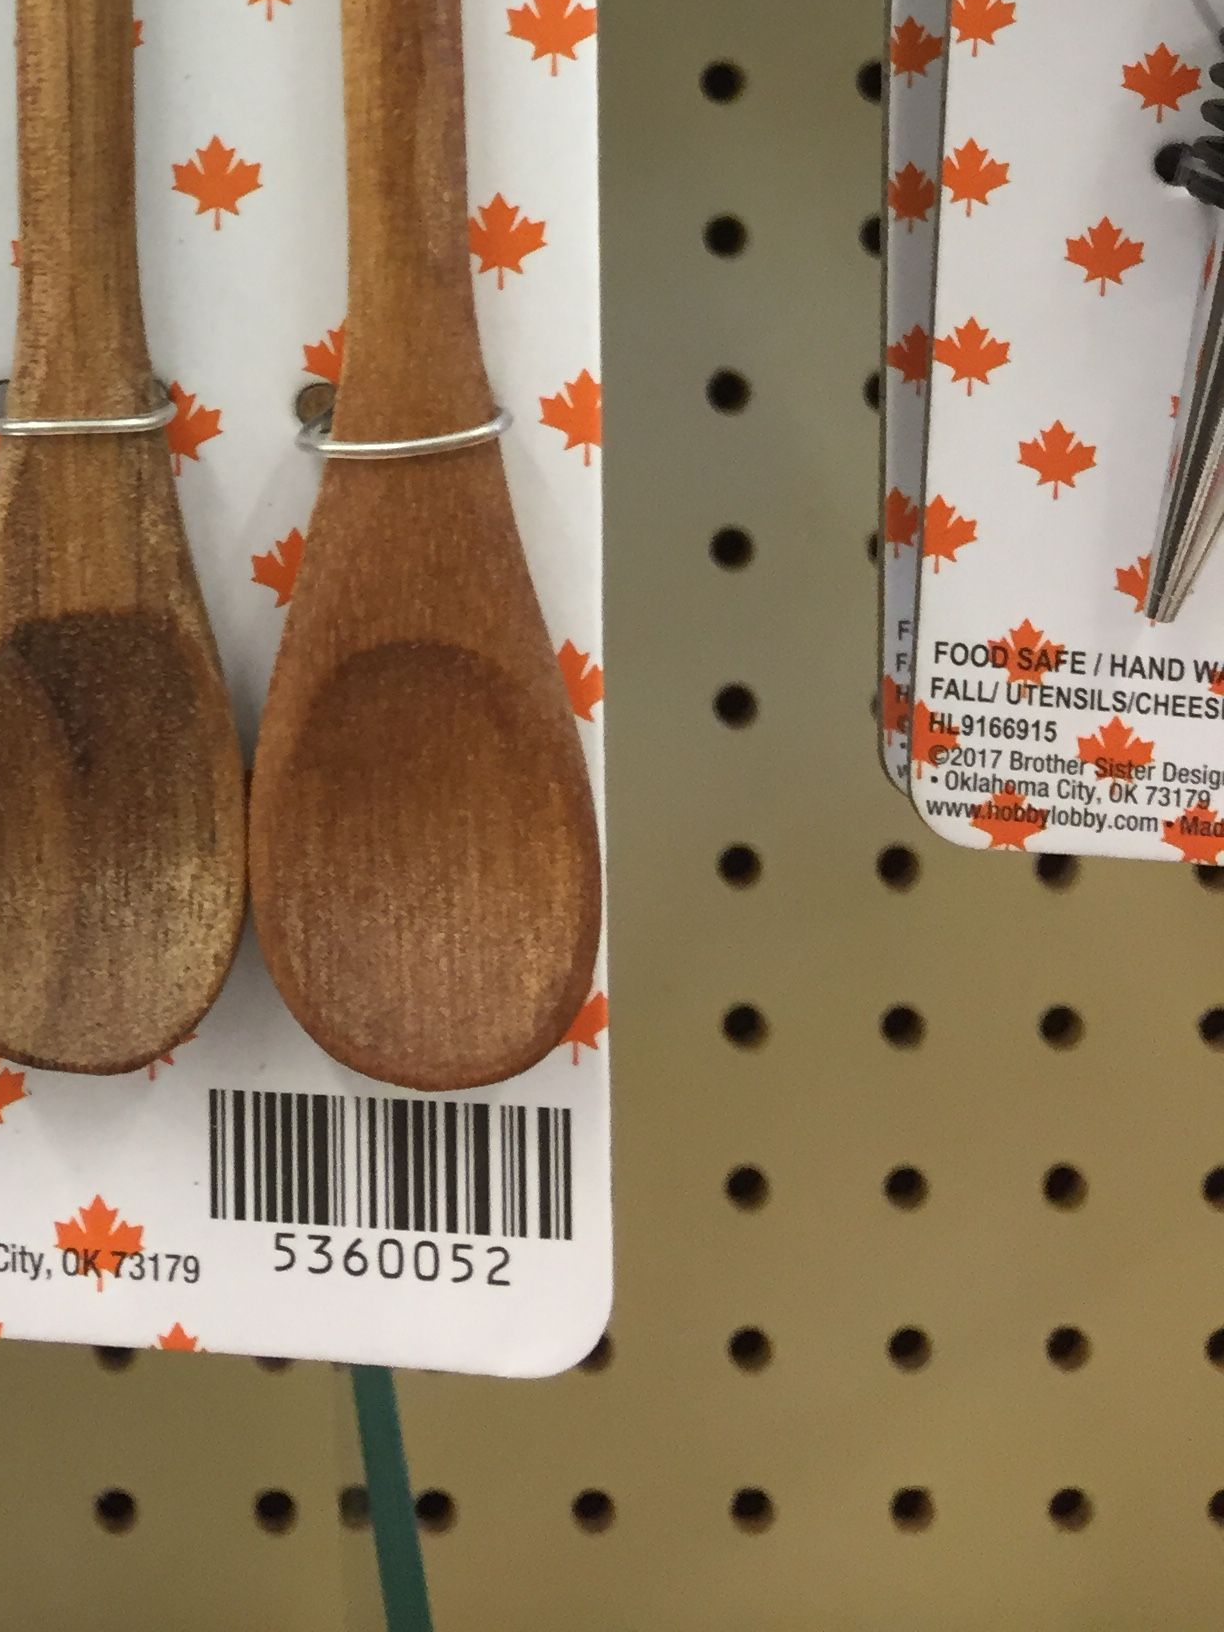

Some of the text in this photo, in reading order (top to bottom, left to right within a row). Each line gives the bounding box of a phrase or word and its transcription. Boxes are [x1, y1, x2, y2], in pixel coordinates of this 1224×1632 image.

[934, 642, 1009, 669] FOOD
[1017, 646, 1087, 676] SAFE
[1110, 654, 1185, 682] HAND
[931, 677, 1000, 704] FALL/
[1006, 684, 1224, 719] UTENSILS/CHEES
[928, 711, 1057, 744] HL9166915
[928, 745, 1224, 790] ©2017 Brother Sister Desig
[945, 770, 1210, 810] Oklahoma City, OK 73179
[926, 799, 1159, 834] www.hobbylobby.com
[63, 1247, 103, 1279] OK
[111, 1250, 201, 1285] 73179
[273, 1232, 511, 1287] 5360052
